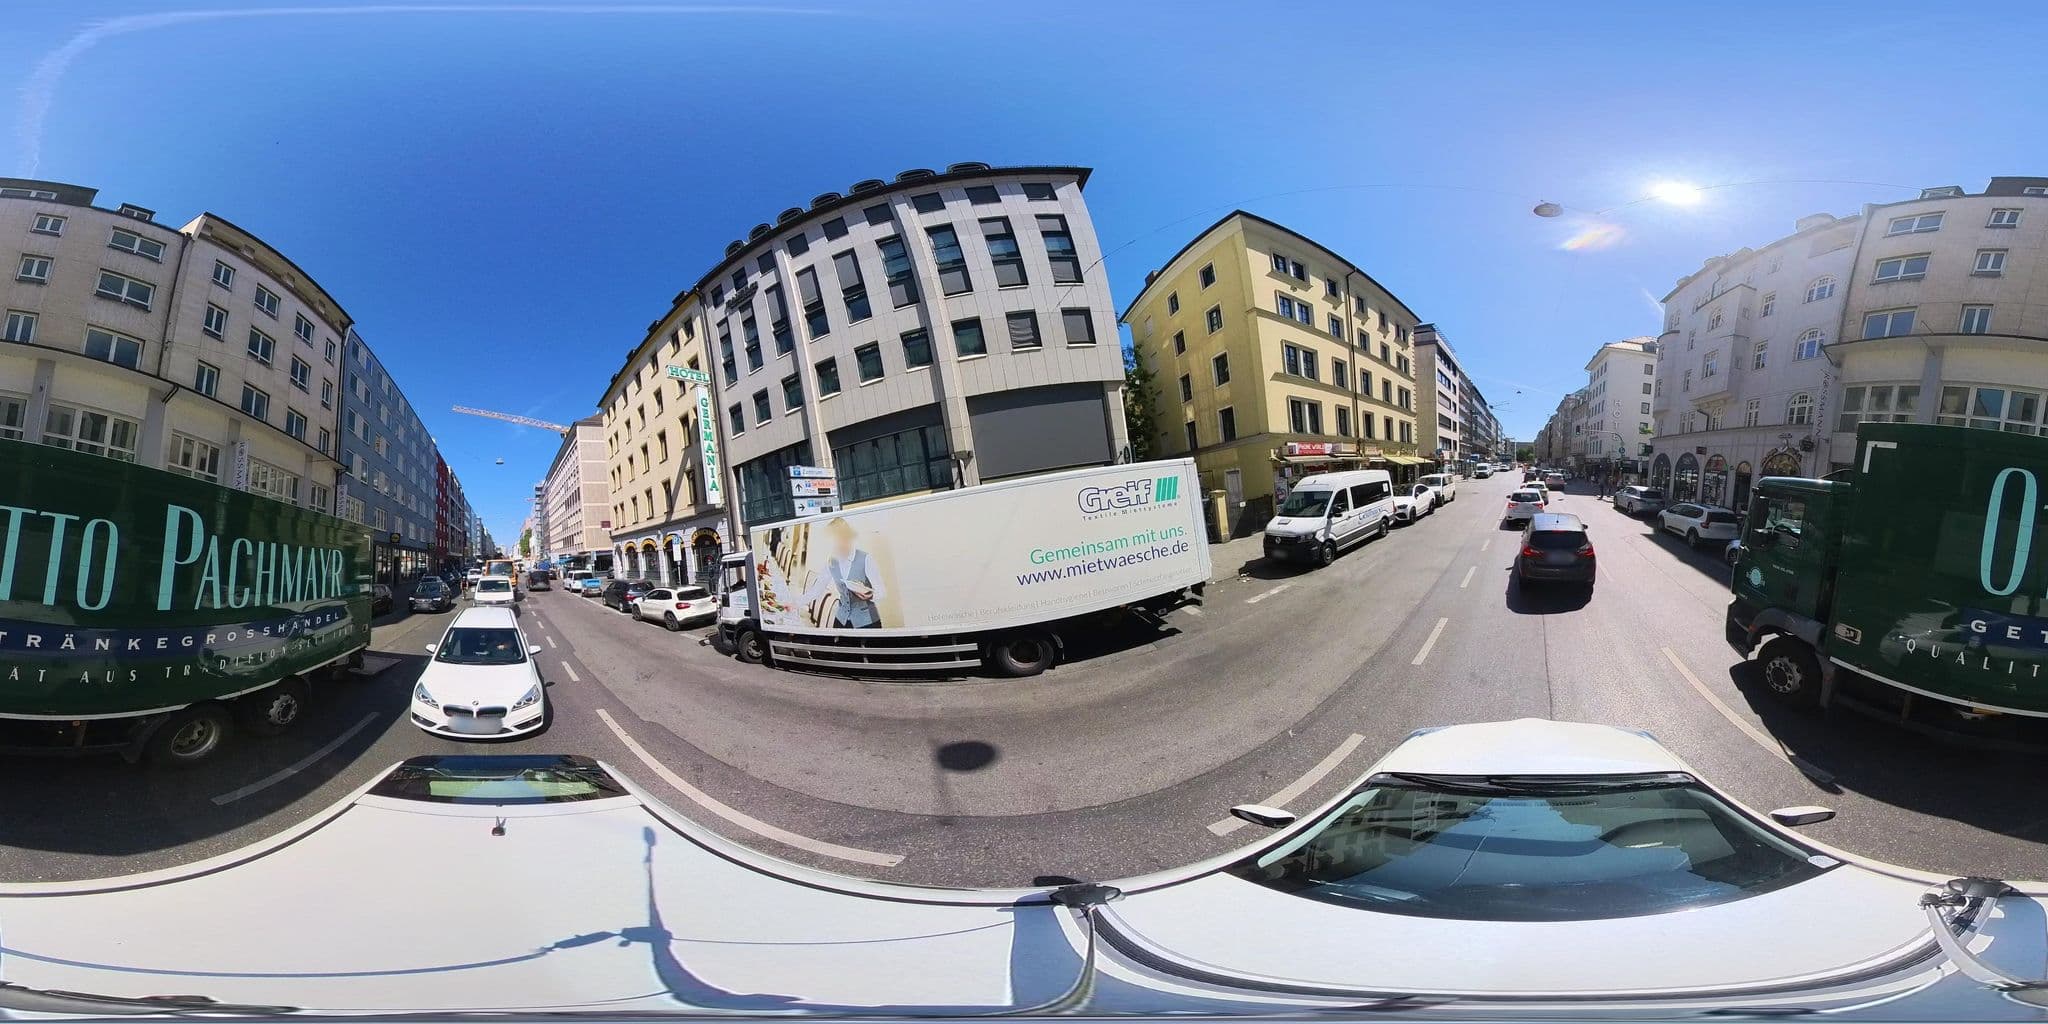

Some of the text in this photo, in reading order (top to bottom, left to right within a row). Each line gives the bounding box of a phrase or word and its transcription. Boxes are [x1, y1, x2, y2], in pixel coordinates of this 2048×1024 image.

[669, 366, 709, 383] HOTEL
[700, 398, 719, 491] GERMANIA
[1078, 479, 1151, 514] Greif
[1082, 512, 1117, 522] Textile
[156, 503, 343, 611] PACHMAYR
[1017, 540, 1189, 586] www.mietwaesche.de
[1030, 525, 1188, 565] Gemeinsam mit uns.
[80, 669, 137, 684] AUS
[1906, 638, 2041, 678] QUALIT
